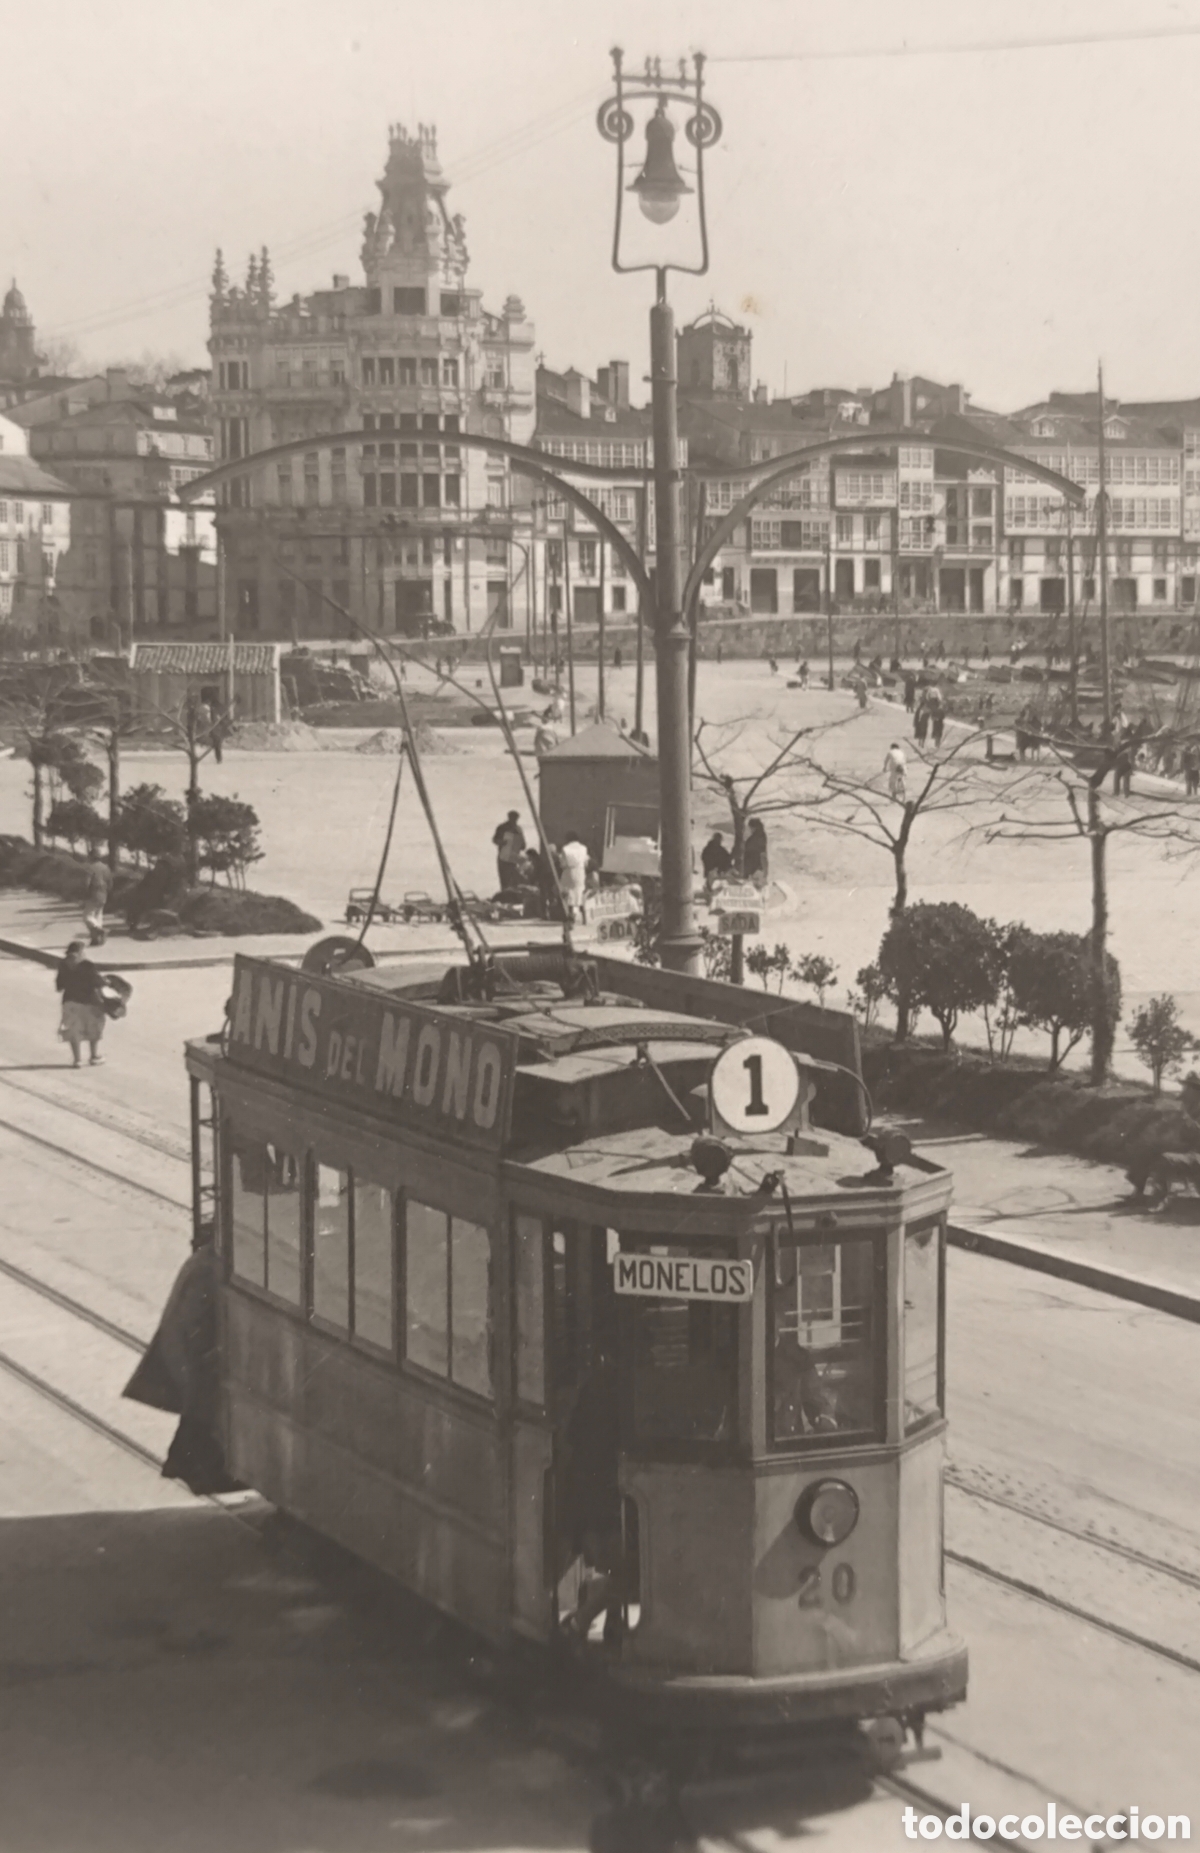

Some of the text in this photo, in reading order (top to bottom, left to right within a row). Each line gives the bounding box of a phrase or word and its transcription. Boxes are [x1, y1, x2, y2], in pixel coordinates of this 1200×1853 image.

[233, 969, 501, 1129] ANIS DEL MONO
[743, 1055, 769, 1116] 1
[618, 1259, 746, 1296] MONELOS
[798, 1562, 856, 1610] 20
